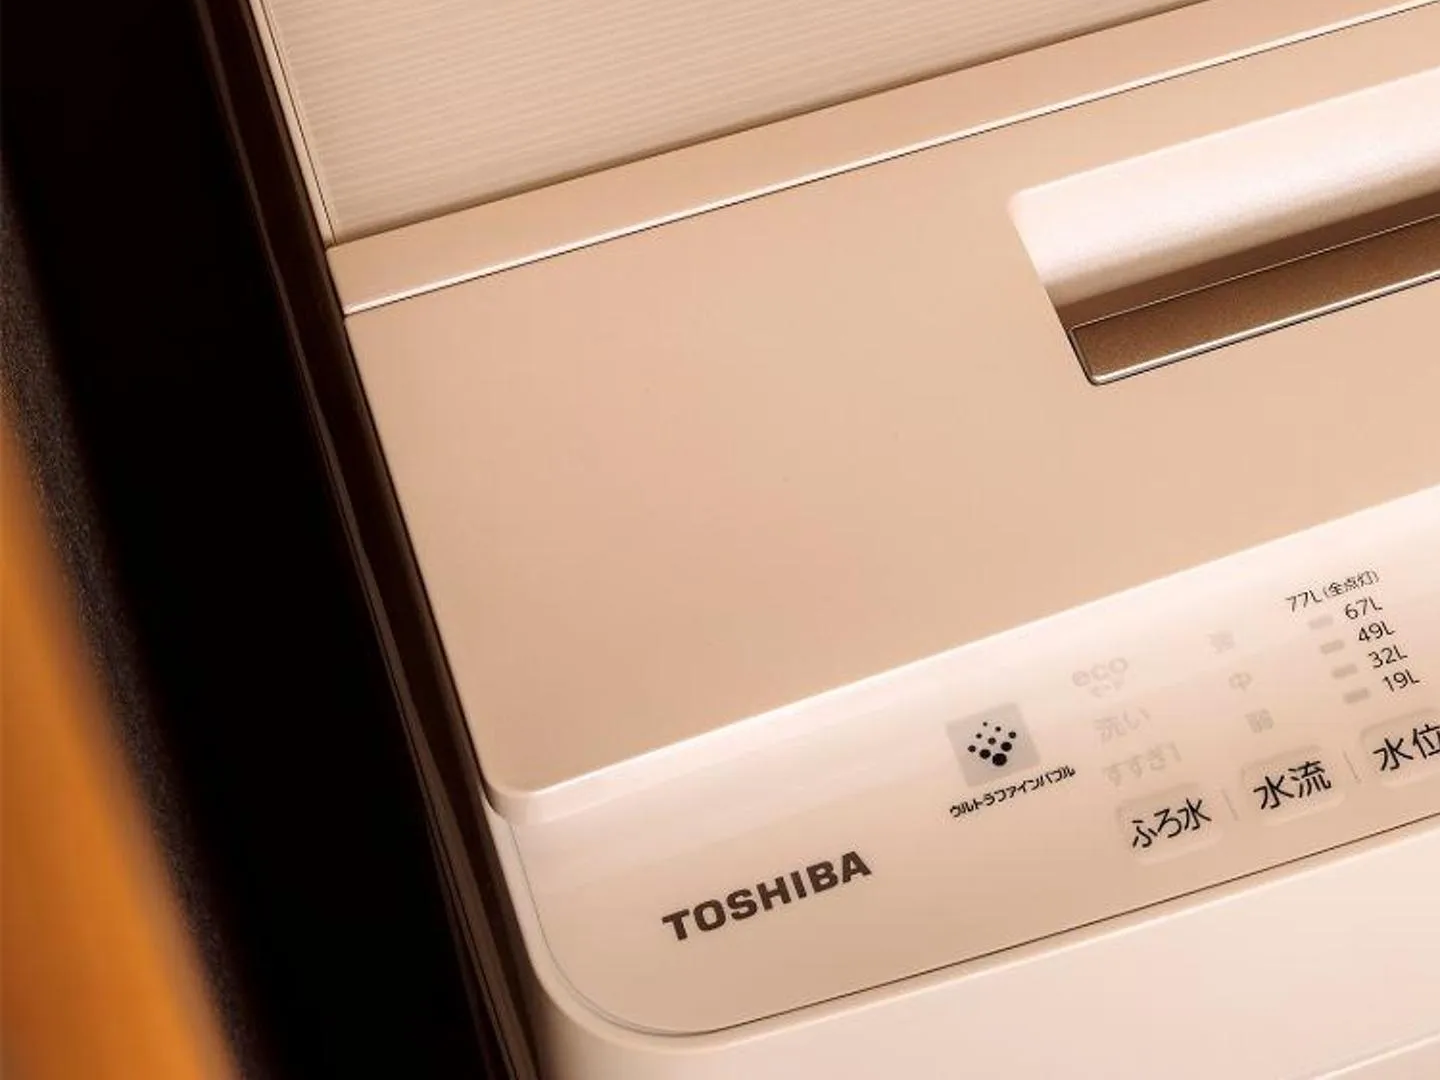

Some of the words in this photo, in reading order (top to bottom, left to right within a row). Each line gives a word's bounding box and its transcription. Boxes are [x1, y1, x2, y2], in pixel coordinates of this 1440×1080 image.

[1344, 596, 1383, 620] 67L
[1357, 620, 1396, 643] 49L
[1368, 643, 1408, 669] 32L
[1382, 669, 1421, 693] 19L
[1253, 760, 1332, 810] 水流
[1131, 797, 1213, 849] ふろ水
[661, 850, 872, 941] TOSHIBA
